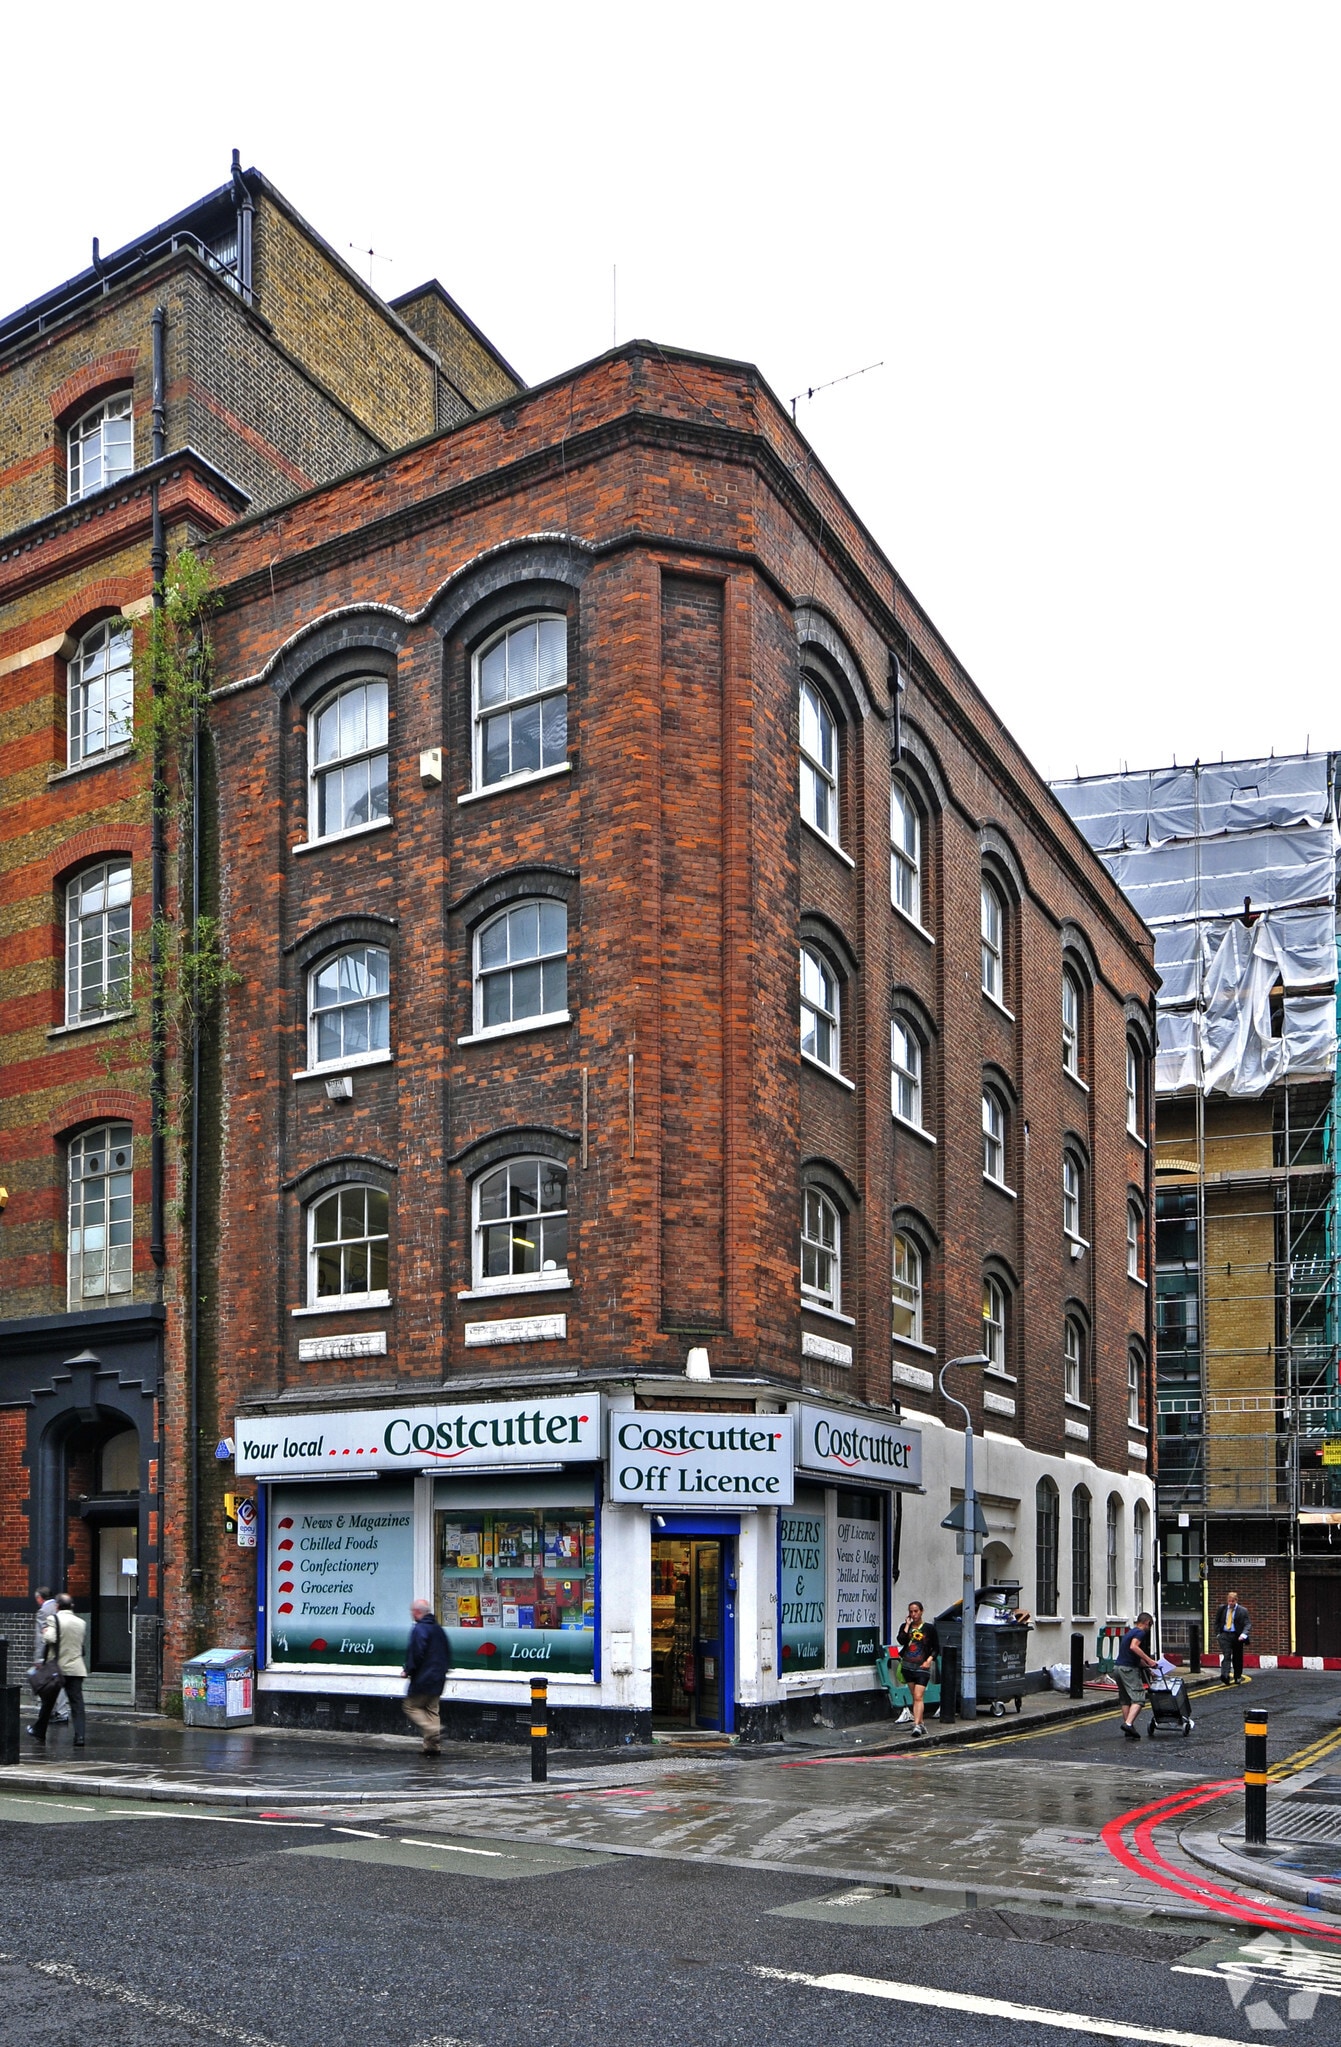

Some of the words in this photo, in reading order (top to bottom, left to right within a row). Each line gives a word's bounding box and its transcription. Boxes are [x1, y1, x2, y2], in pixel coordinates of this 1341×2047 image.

[384, 1409, 589, 1457] Costcutter
[618, 1423, 783, 1452] Costcutter
[243, 1440, 279, 1460] Your
[283, 1435, 324, 1458] local
[814, 1420, 912, 1469] Costcutter
[619, 1466, 671, 1491] Off
[678, 1468, 780, 1493] Licence
[240, 1525, 255, 1535] epay
[301, 1516, 333, 1529] News
[336, 1515, 346, 1529] &
[348, 1513, 410, 1532] Magazines
[781, 1519, 821, 1543] BEERS
[838, 1523, 850, 1543] Off
[851, 1525, 876, 1541] Licence
[300, 1537, 341, 1551] Chilled
[345, 1535, 378, 1550] Foods
[300, 1558, 379, 1576] Confectionery
[855, 1549, 861, 1563] &
[862, 1550, 880, 1569] Mags
[795, 1575, 805, 1596] &
[861, 1569, 879, 1584] Foods
[301, 1580, 354, 1594] Groceries
[837, 1588, 860, 1602] Frozen
[300, 1602, 338, 1615] Frozen
[342, 1601, 375, 1615] Foods
[781, 1601, 825, 1624] PIRITS
[837, 1609, 855, 1623] Fruit
[856, 1608, 862, 1623] &
[864, 1609, 876, 1626] Veg
[339, 1638, 375, 1654] Fresh
[510, 1642, 553, 1660] Local
[797, 1643, 819, 1658] Value
[856, 1639, 875, 1654] Fresh
